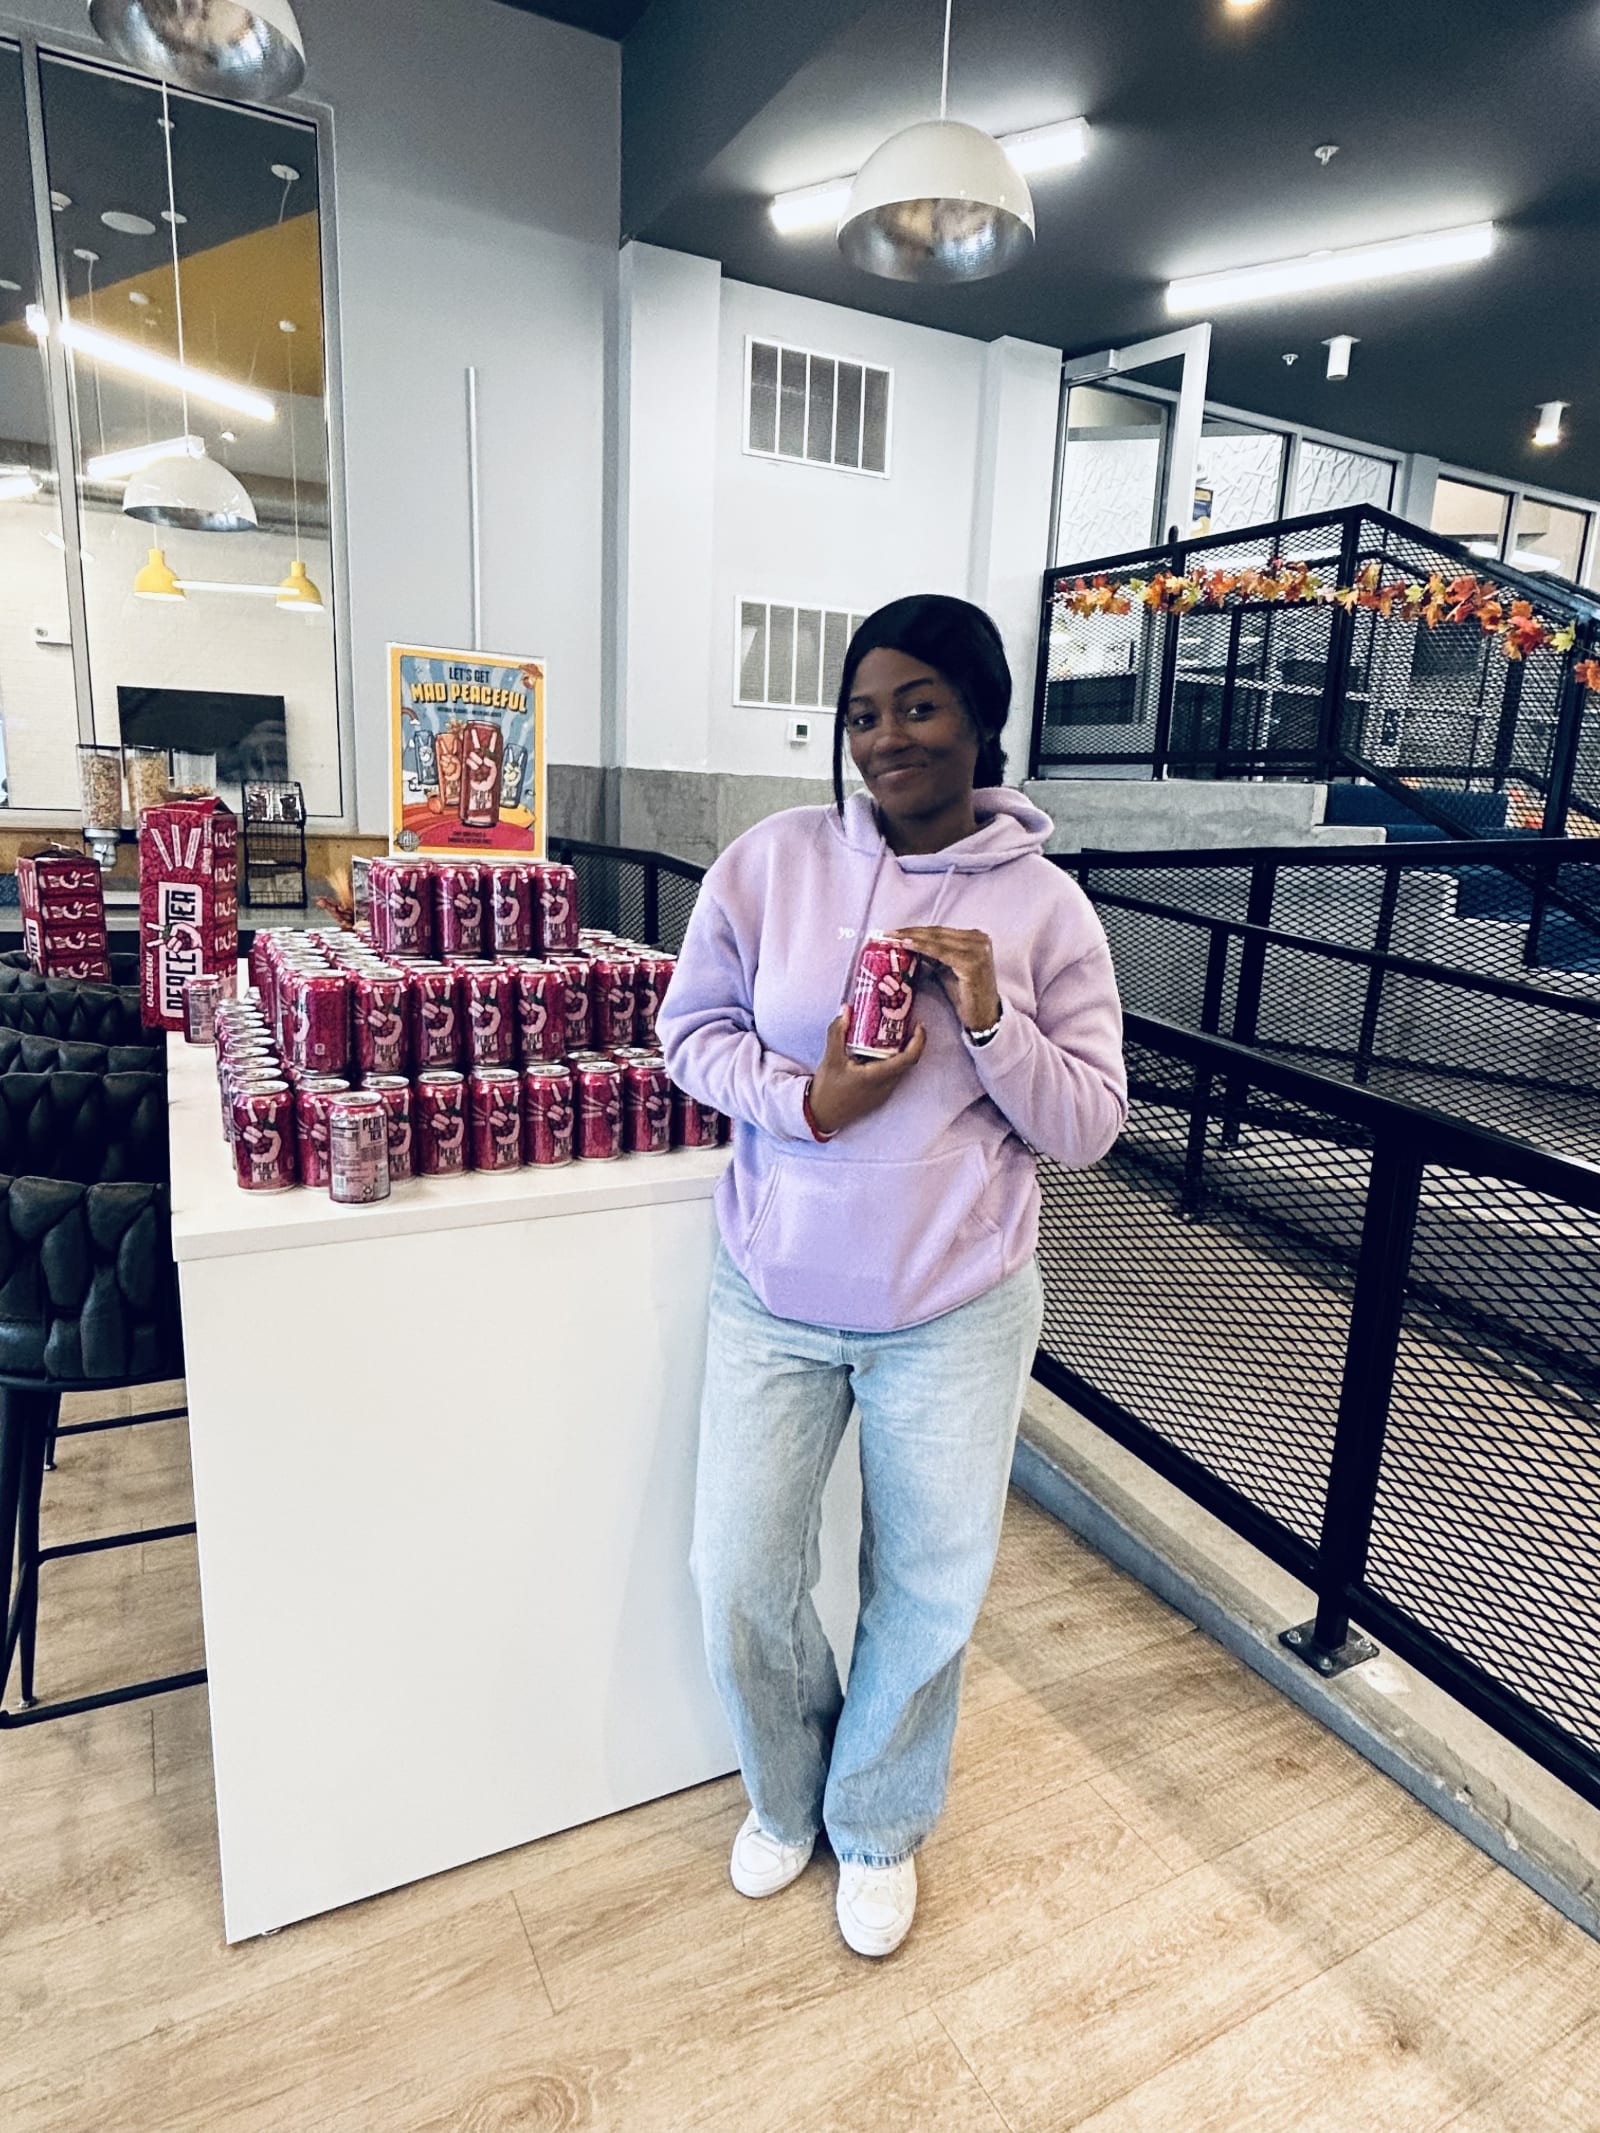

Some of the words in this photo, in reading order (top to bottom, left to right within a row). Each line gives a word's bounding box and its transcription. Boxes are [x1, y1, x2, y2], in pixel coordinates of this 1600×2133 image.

[449, 666, 473, 682] LET'S
[474, 669, 490, 683] GET
[410, 681, 447, 703] MAD
[450, 682, 528, 714] PEACEFUL
[166, 889, 196, 926] TEA
[145, 952, 155, 1008] RAZZLEBERRY
